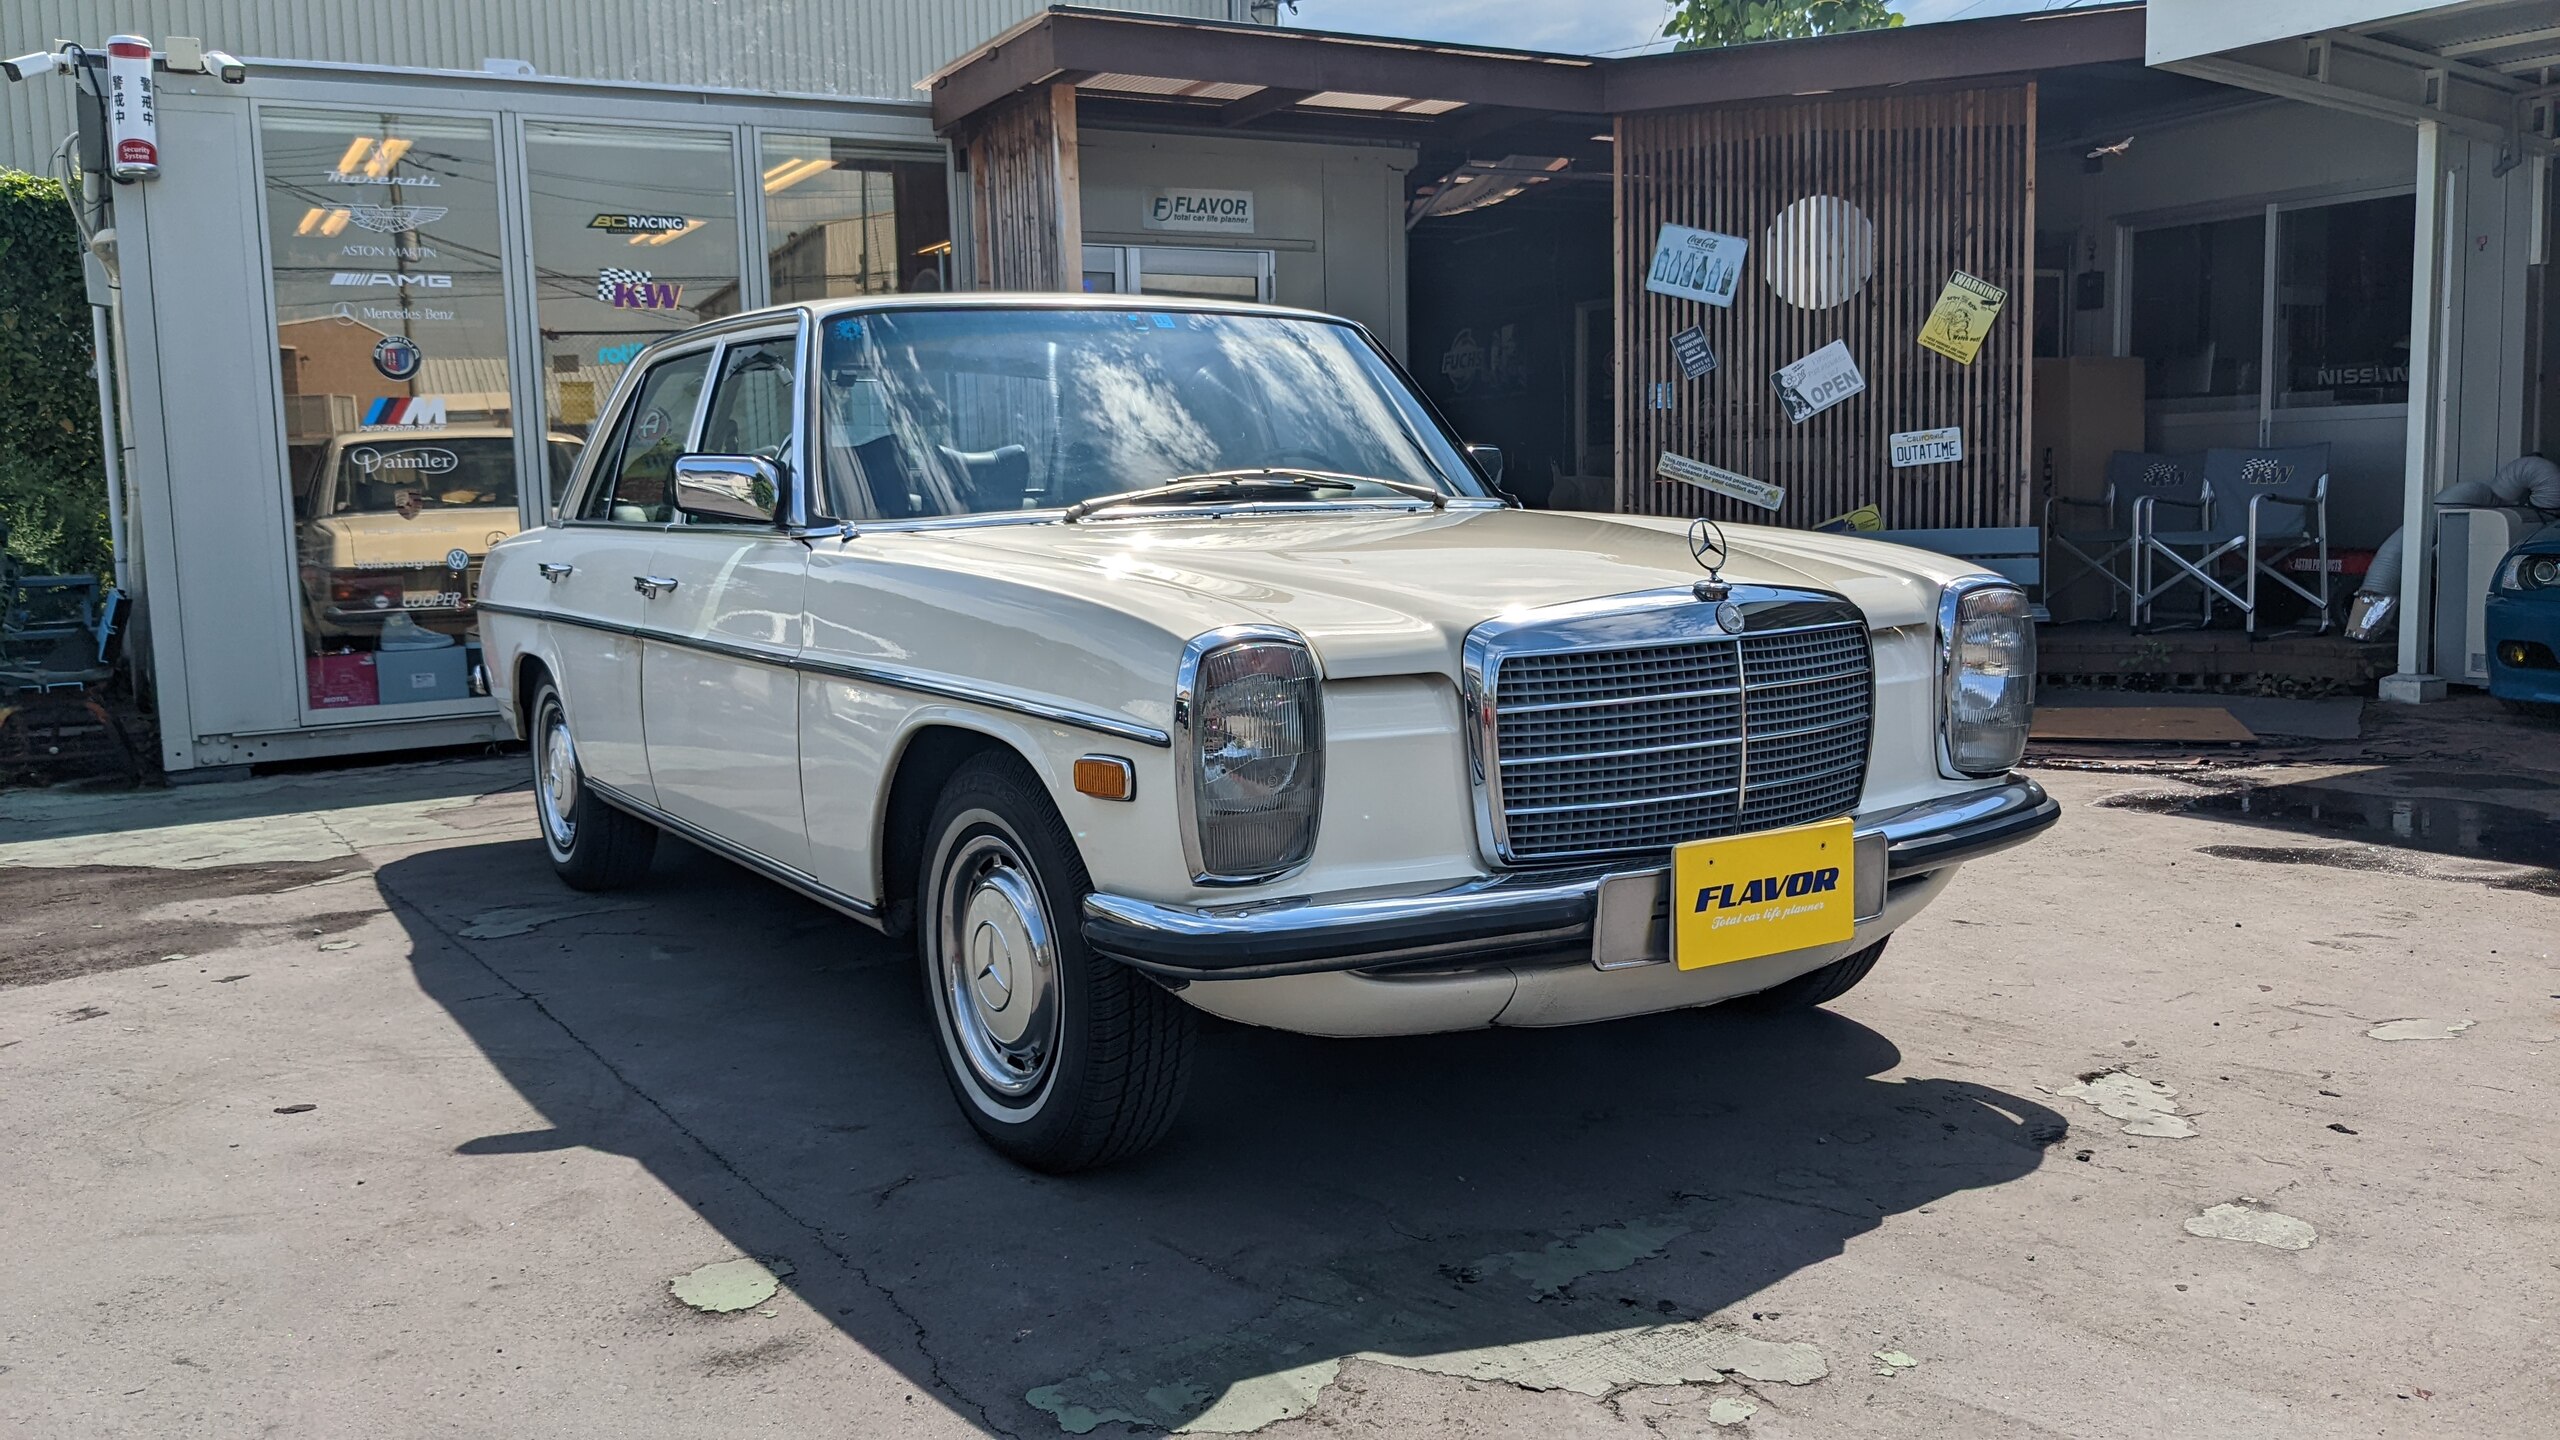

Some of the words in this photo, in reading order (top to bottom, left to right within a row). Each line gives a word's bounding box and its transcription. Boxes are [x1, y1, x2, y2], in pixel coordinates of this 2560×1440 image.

[122, 145, 150, 155] Security
[124, 152, 150, 161] System
[324, 170, 441, 187] Maserati
[1175, 196, 1248, 216] FLAVOR
[1206, 214, 1218, 223] life
[1220, 215, 1248, 224] planner
[341, 245, 385, 257] ASTON
[388, 246, 437, 259] MARTIN
[367, 273, 452, 288] AMG
[1953, 272, 2003, 302] WARNING
[614, 282, 684, 310] KW
[425, 308, 455, 321] Benz
[374, 337, 420, 360] ALPINA
[1677, 337, 1704, 353] PARKING
[1685, 346, 1701, 357] ONLY
[1444, 351, 1483, 371] FUCHS
[2317, 366, 2408, 385] NISSAN
[1810, 369, 1859, 404] OPEN
[359, 424, 447, 433] PERFORMANCE
[352, 447, 454, 474] Daimler
[1896, 440, 1957, 462] OUTATIME
[1664, 455, 1676, 465] This
[1676, 458, 1688, 468] rest
[1688, 462, 1703, 472] room
[1709, 469, 1732, 481] checked
[1732, 477, 1765, 492] periodically
[1702, 474, 1712, 482] for
[1711, 477, 1725, 486] your
[1725, 482, 1747, 492] comfort
[1747, 487, 1758, 496] and
[2312, 558, 2342, 572] PRUCTS
[403, 592, 462, 608] COOPER
[1694, 867, 1839, 913] FLAVOR
[1711, 913, 1742, 930] Total
[1743, 913, 1761, 924] car
[1763, 906, 1781, 923] life
[1782, 901, 1825, 920] planner
